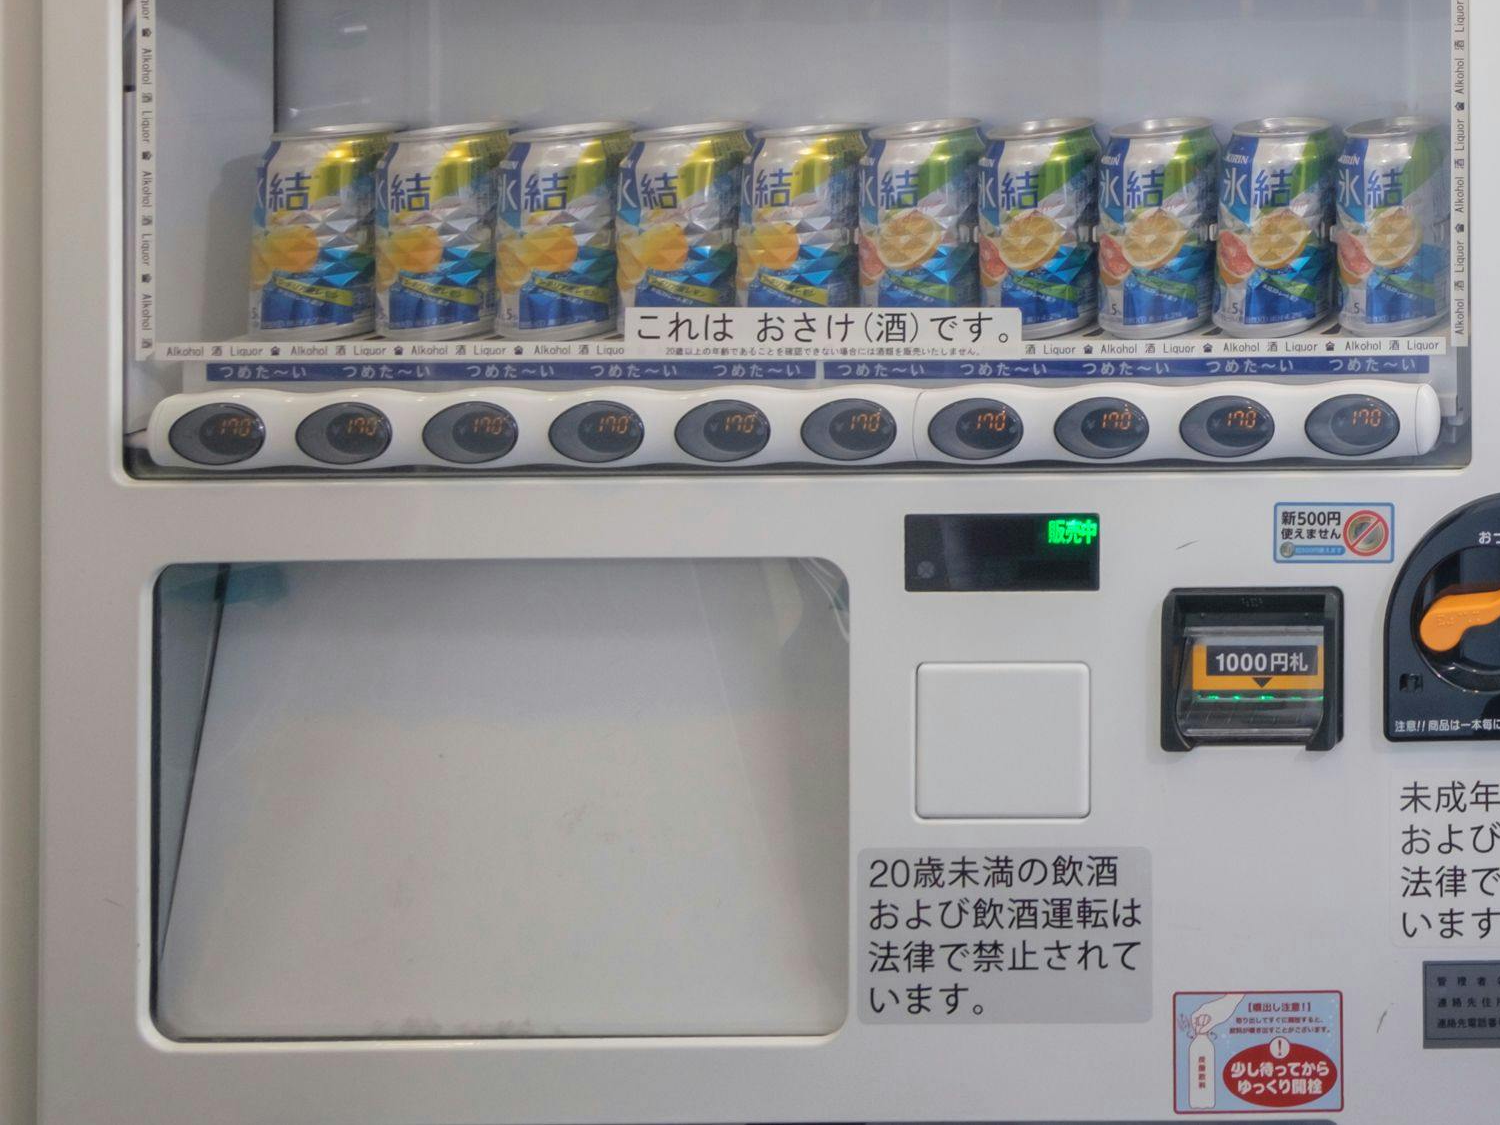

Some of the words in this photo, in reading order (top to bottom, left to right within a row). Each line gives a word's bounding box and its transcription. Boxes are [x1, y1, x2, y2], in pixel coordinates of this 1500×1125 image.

[1221, 167, 1291, 209] 氷結
[1339, 168, 1403, 209] 氷結
[638, 311, 734, 343] これは
[1345, 341, 1382, 351] Alkohol
[1407, 340, 1440, 352] Liquor
[1048, 520, 1098, 545] 販売中
[1281, 511, 1341, 526] 新500円
[1281, 528, 1342, 540] 使えません
[1215, 652, 1309, 672] 1000円札
[868, 855, 1119, 889] 20歳未満の飲酒
[868, 895, 1143, 930] および飲酒運転は
[868, 938, 1142, 974] 法律で禁止されて
[868, 984, 989, 1017] います。
[1231, 1061, 1330, 1078] 少し待ってから
[1238, 1078, 1323, 1095] ゆっくり開栓
